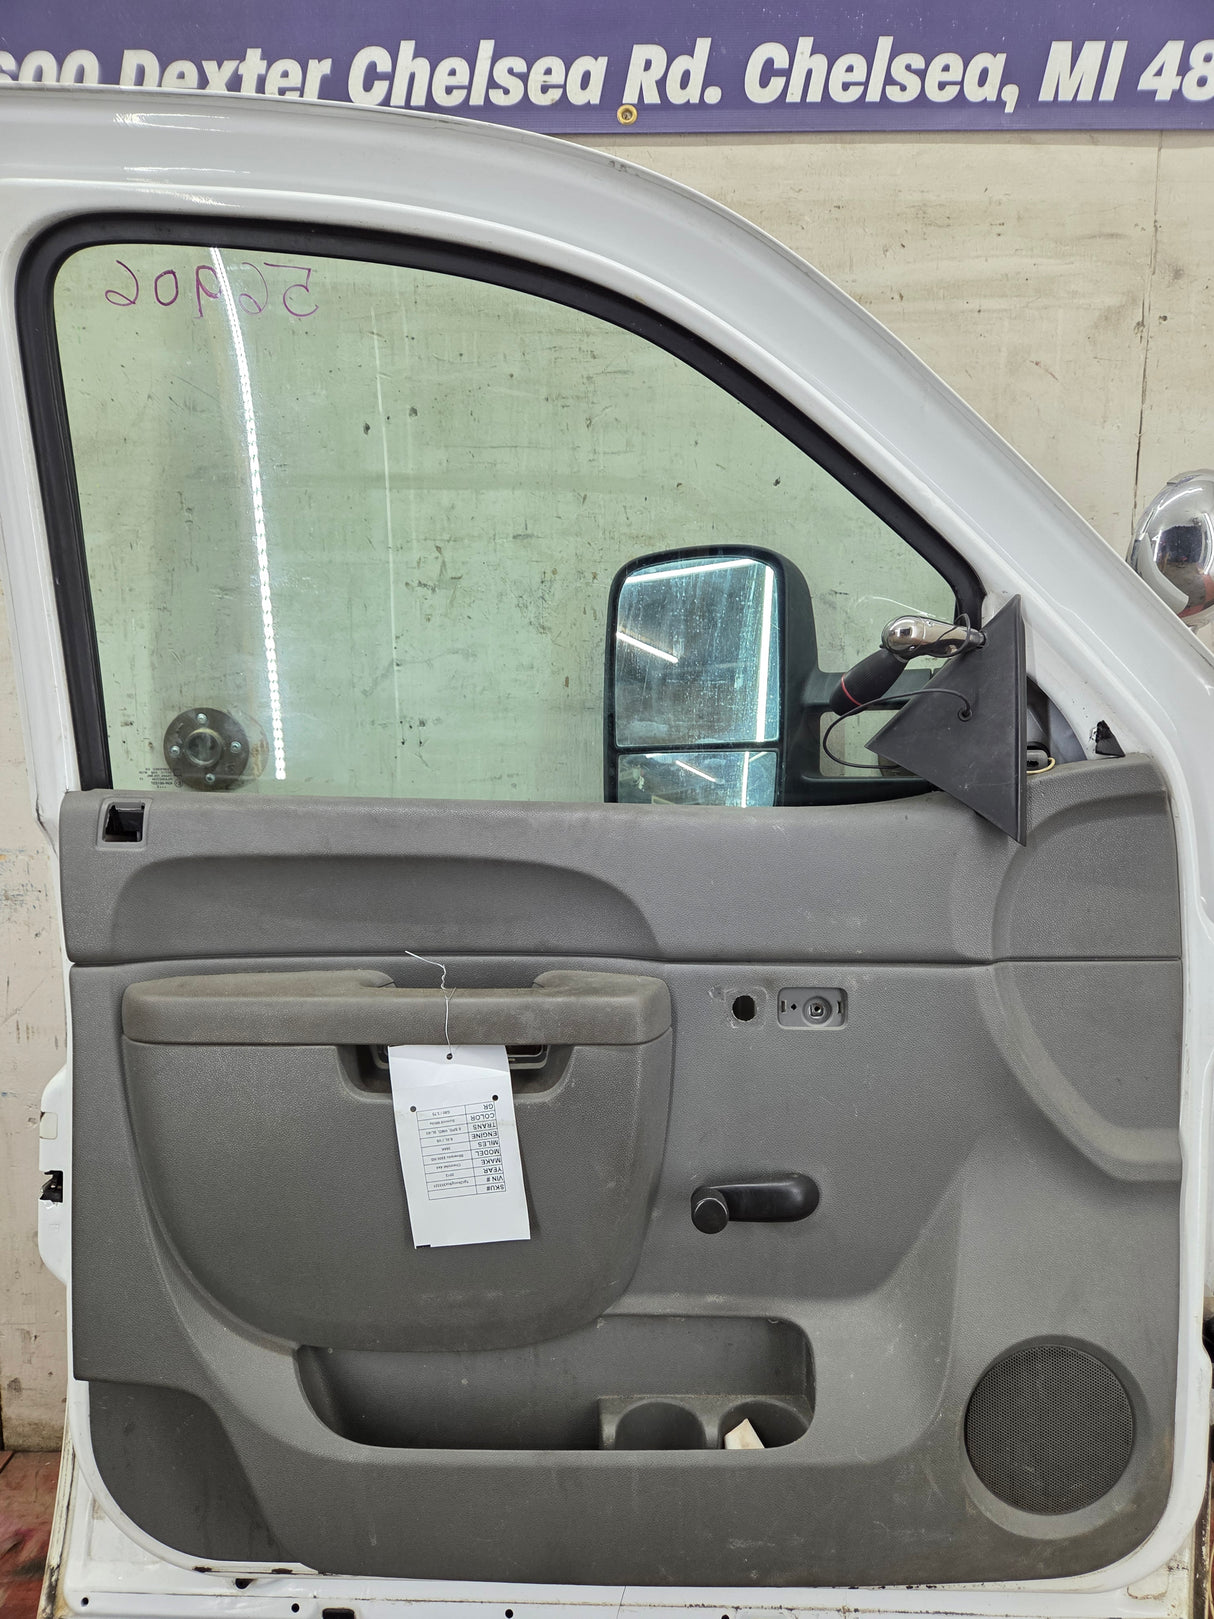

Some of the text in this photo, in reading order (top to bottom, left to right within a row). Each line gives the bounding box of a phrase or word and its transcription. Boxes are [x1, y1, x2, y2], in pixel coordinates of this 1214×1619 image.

[119, 48, 333, 99] Dexter
[347, 39, 608, 106] Chelsea
[622, 37, 722, 105] Rd.
[744, 36, 1019, 113] Chelsea,
[1038, 40, 1128, 102] MI
[470, 1112, 495, 1121] COLOR
[472, 1121, 496, 1130] TRANS
[471, 1130, 498, 1139] ENGINE
[475, 1148, 500, 1156] MODEL
[480, 1157, 501, 1165] MAKE
